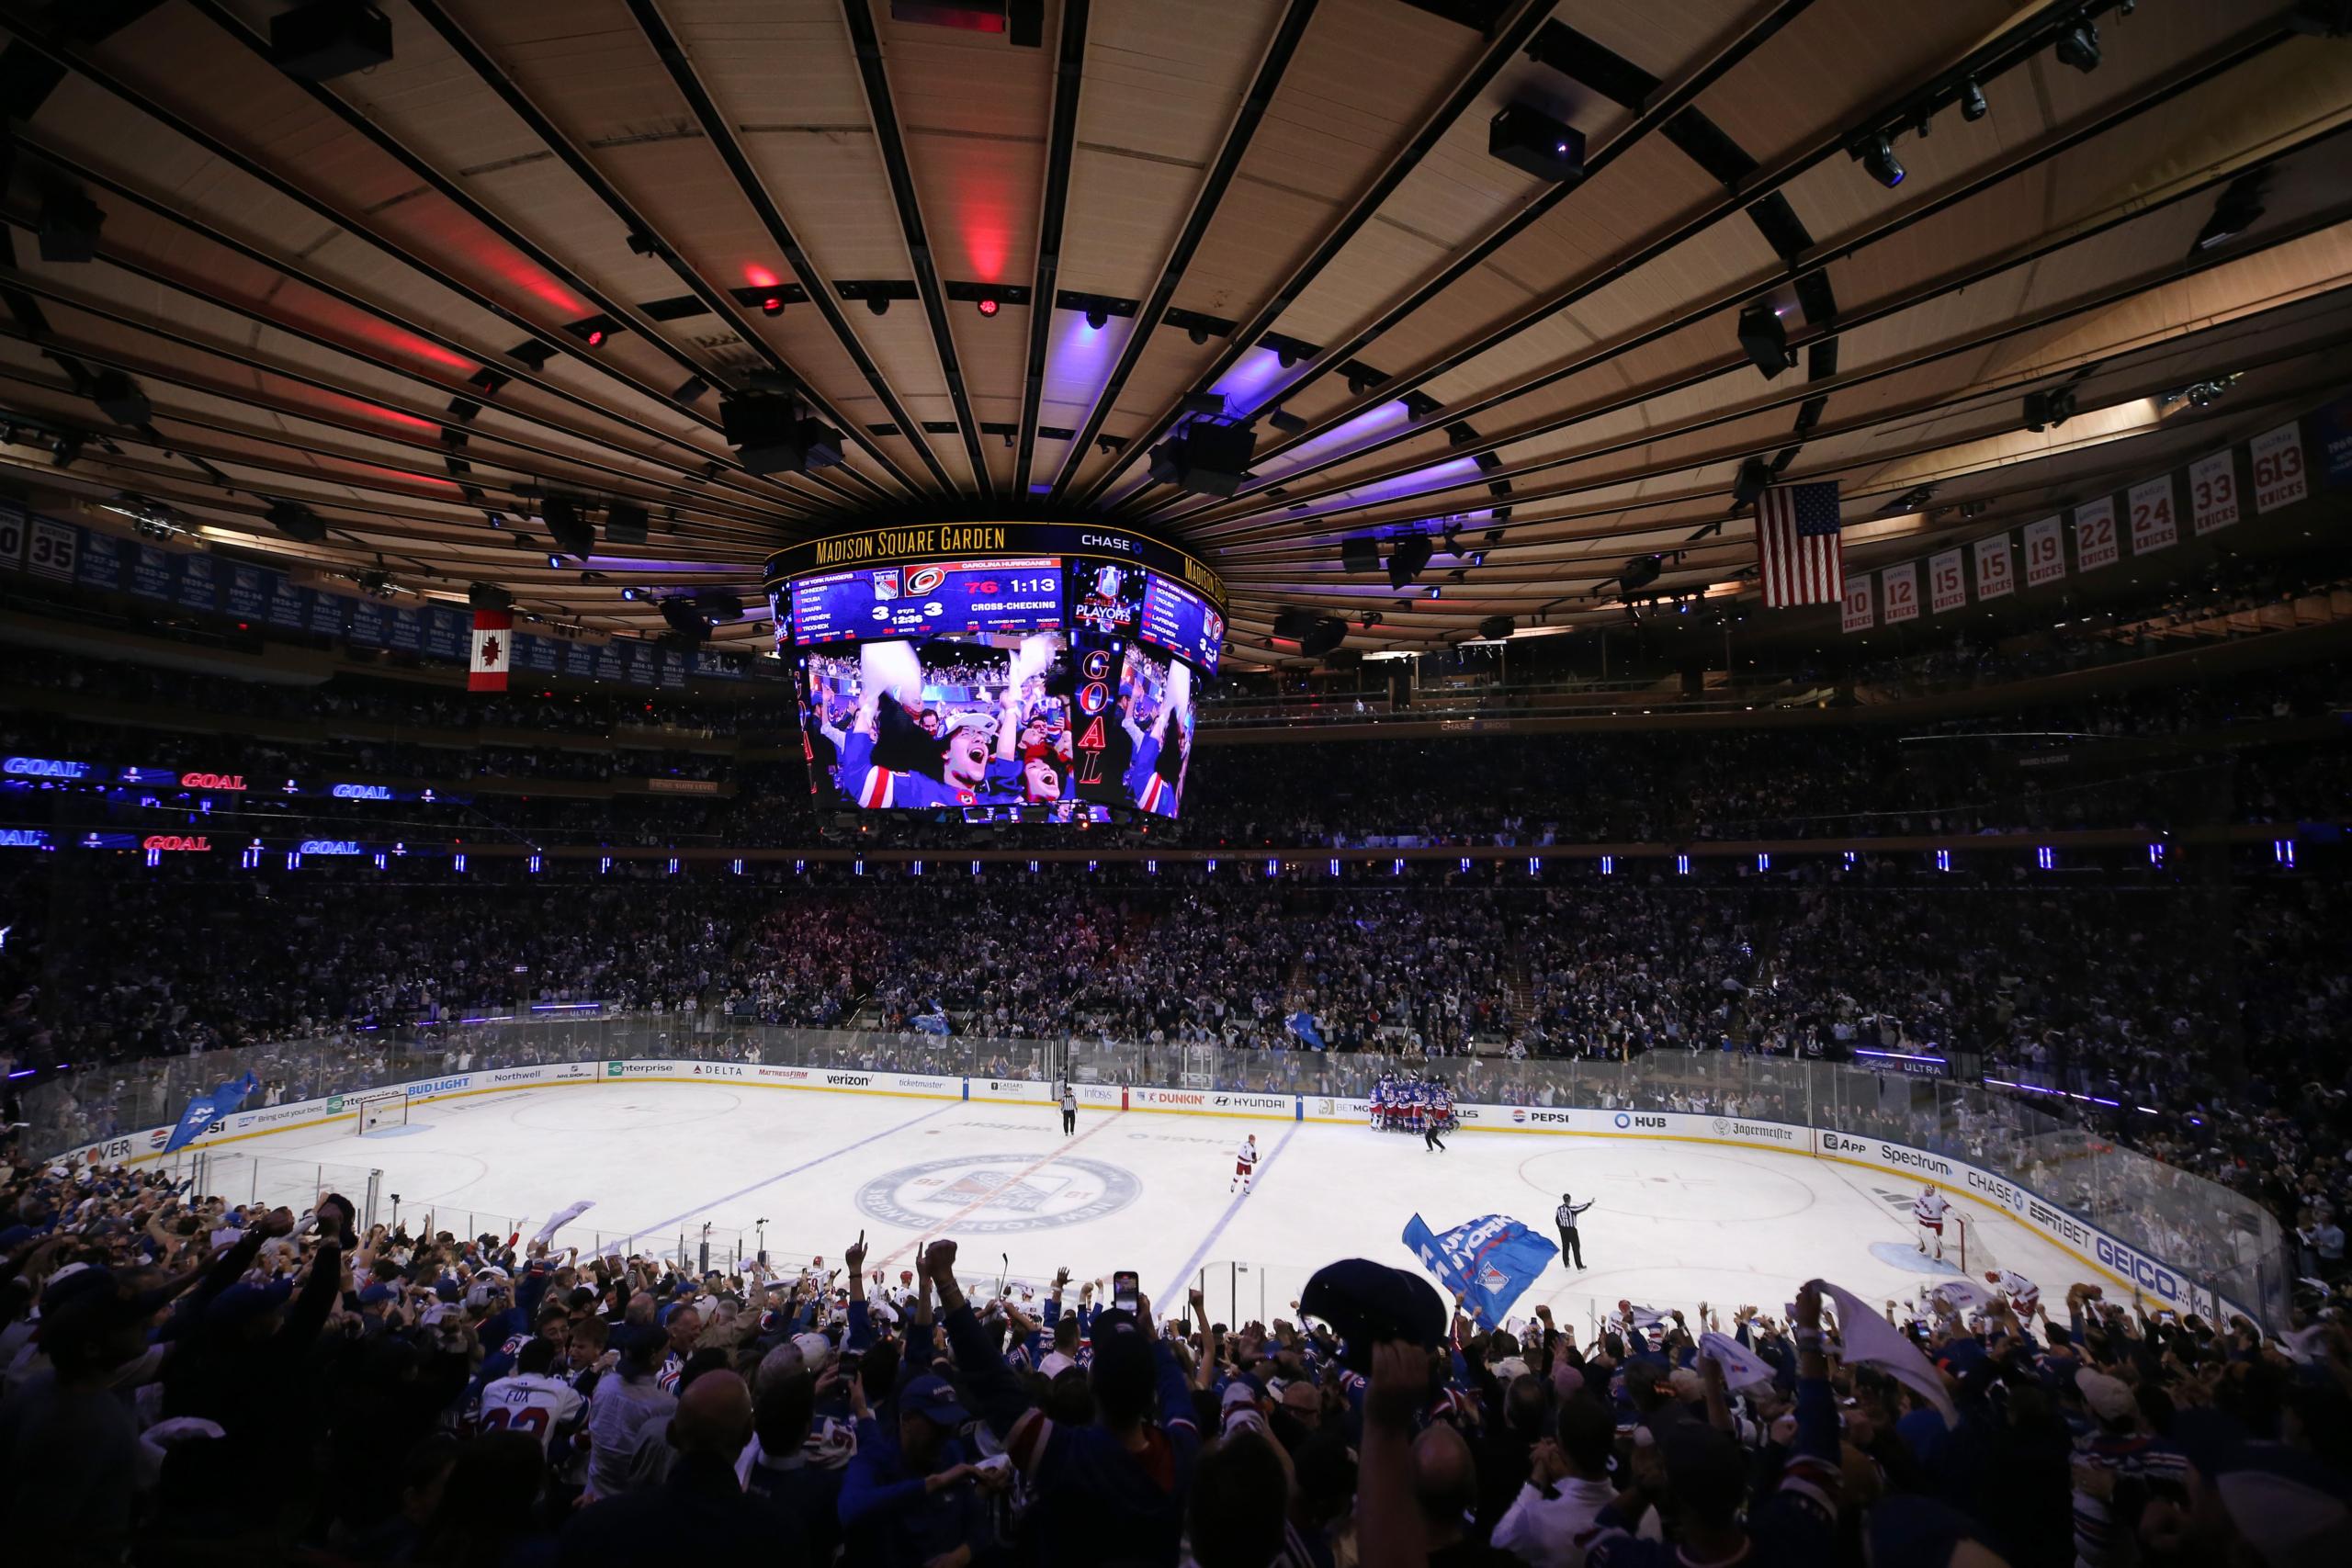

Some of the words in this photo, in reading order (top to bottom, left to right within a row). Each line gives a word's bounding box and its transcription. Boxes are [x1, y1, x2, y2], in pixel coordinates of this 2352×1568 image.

[2255, 446, 2302, 488] 613
[2195, 474, 2232, 510] 33
[2258, 480, 2303, 506] KNICKS
[2133, 498, 2171, 533] 24
[2197, 506, 2236, 530] KNICKS
[2080, 518, 2112, 550] 22
[2135, 528, 2175, 550] KNICKS
[816, 536, 873, 565] MADISON
[877, 530, 935, 556] SQUARE
[941, 526, 1005, 550] GARDEN
[1081, 535, 1130, 551] CHASE
[2031, 536, 2056, 566] 19
[33, 536, 73, 568] 35
[2081, 547, 2116, 567] KNICKS
[1001, 559, 1052, 568] HURRICANES
[1982, 553, 2006, 581] 15
[1185, 557, 1215, 595] MADISON
[1936, 568, 1959, 594] 15
[2030, 563, 2064, 582] KNICKS
[965, 581, 998, 594] 76
[1011, 579, 1056, 592] 1:13
[1889, 581, 1912, 605] 12
[1980, 579, 2012, 597] KNICKS
[923, 602, 944, 616] 3
[971, 601, 1056, 612] CROSS-CHECKING
[1847, 592, 1867, 615] 10
[1934, 592, 1964, 609] KNICKS
[872, 605, 889, 620] 3
[891, 615, 923, 625] 12:36
[1076, 604, 1131, 622] PLAYOFFS
[1886, 604, 1917, 620] KNICKS
[1844, 615, 1871, 629] KNICKS
[1078, 650, 1110, 784] GOAL
[1441, 722, 1473, 731] CHASE
[4, 757, 82, 778] GOAL
[182, 773, 247, 790] GOAL
[333, 784, 390, 800] GOAL
[143, 835, 211, 852] GOAL
[300, 840, 360, 855] GOAL
[494, 1070, 540, 1082] Northwell
[610, 1064, 673, 1073] enterprise
[706, 1066, 742, 1076] DELTA
[1904, 1063, 1942, 1075] ULTRA
[408, 1083, 432, 1097] BUD
[435, 1077, 469, 1092] LIGHT
[827, 1074, 868, 1086] verizon
[899, 1078, 944, 1089] ticketmaster
[1085, 1088, 1112, 1100] Infosys
[1159, 1093, 1204, 1105] DUNKIN'
[1234, 1097, 1284, 1109] HYUNDAI
[1336, 1104, 1369, 1112] BETMG
[258, 1112, 277, 1122] Bring
[277, 1111, 290, 1119] out
[291, 1109, 304, 1118] your
[1532, 1112, 1569, 1122] PEPSI
[1635, 1116, 1667, 1128] HUB
[1883, 1145, 1949, 1176] Spectrum
[1968, 1171, 2012, 1203] CHASE
[1059, 1201, 1114, 1222] NEW
[2097, 1236, 2177, 1302] GEICO
[505, 1388, 528, 1404] FOX
